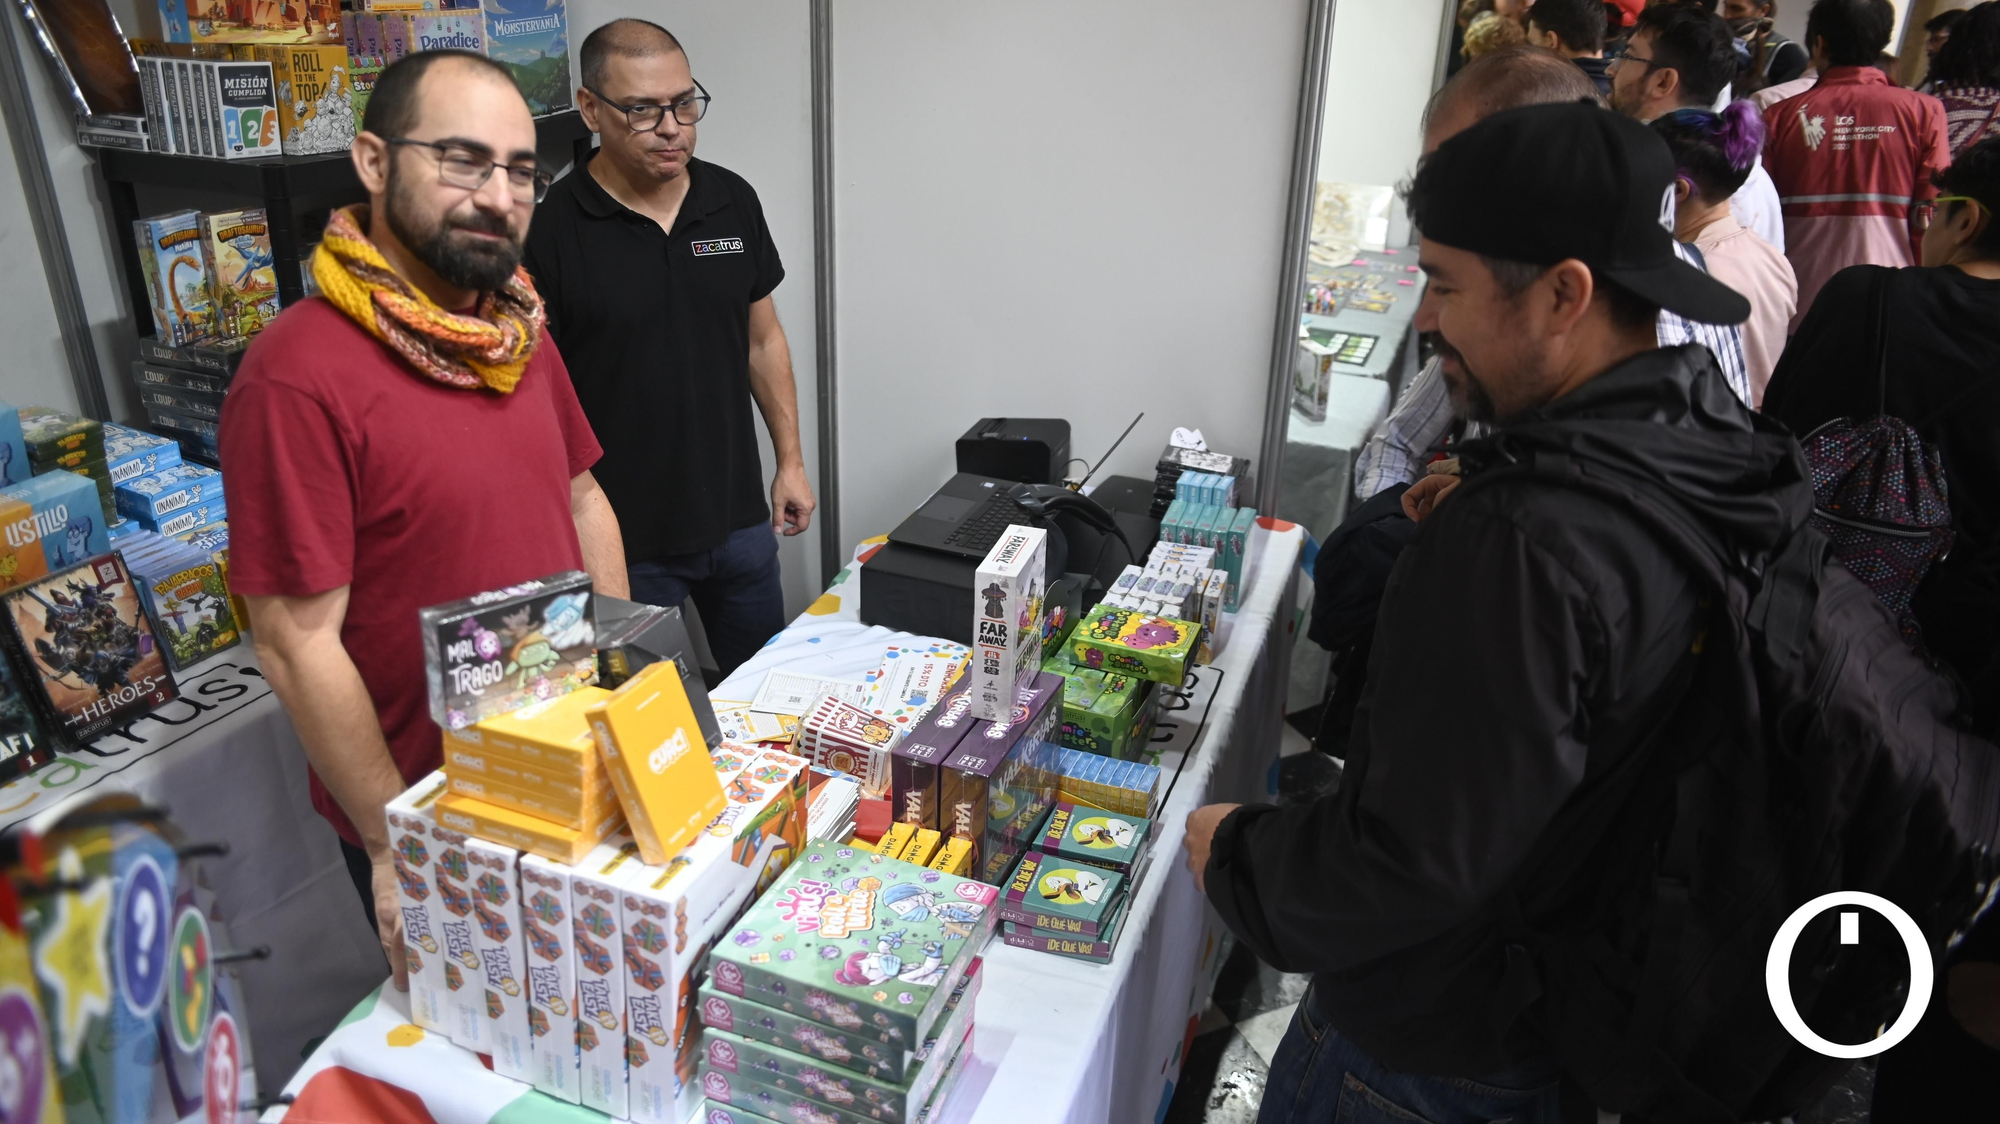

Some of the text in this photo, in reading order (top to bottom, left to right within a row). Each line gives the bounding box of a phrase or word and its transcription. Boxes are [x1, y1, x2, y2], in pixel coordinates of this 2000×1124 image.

[494, 13, 561, 36] MONSTERVANIA
[420, 32, 479, 51] Paradice
[292, 53, 324, 73] ROLL
[224, 75, 269, 89] MISIÓN
[295, 73, 316, 82] TO THE
[228, 89, 267, 97] CUMPLIDA
[296, 82, 327, 102] TOP!
[228, 120, 277, 140] 1 2 3
[1834, 133, 1880, 141] MARATHON
[160, 228, 199, 247] DRAFTOSAURU
[219, 224, 265, 240] DRAFTOSAURUS
[153, 564, 214, 597] PAJARRACOS
[980, 621, 1008, 637] FAR
[1093, 615, 1115, 639] Boomie
[1107, 611, 1131, 636] Busters
[447, 639, 476, 663] MAL
[978, 635, 1007, 648] AWAY
[922, 663, 934, 675] 15%
[1108, 654, 1139, 666] Boomie
[1113, 661, 1148, 674] Busters
[448, 660, 503, 696] TRAGO
[81, 675, 156, 722] HEROES
[156, 692, 165, 702] 2
[26, 756, 38, 767] 1
[401, 906, 422, 947] EASY!
[413, 904, 430, 938] TAKE
[1037, 915, 1082, 933] ¡DE QUÉ VAS!
[442, 922, 464, 963] EASY!
[454, 920, 472, 954] TAKE
[1047, 938, 1093, 955] ¡DE QUÉ VAS!
[481, 949, 503, 990] EASY!
[493, 946, 511, 980] TAKE
[530, 966, 551, 1007] EASY!
[542, 965, 561, 998] TAKE
[580, 980, 601, 1022] EASY!
[593, 978, 611, 1012] TAKE
[629, 996, 651, 1038] EASY!
[642, 994, 661, 1028] TAKE
